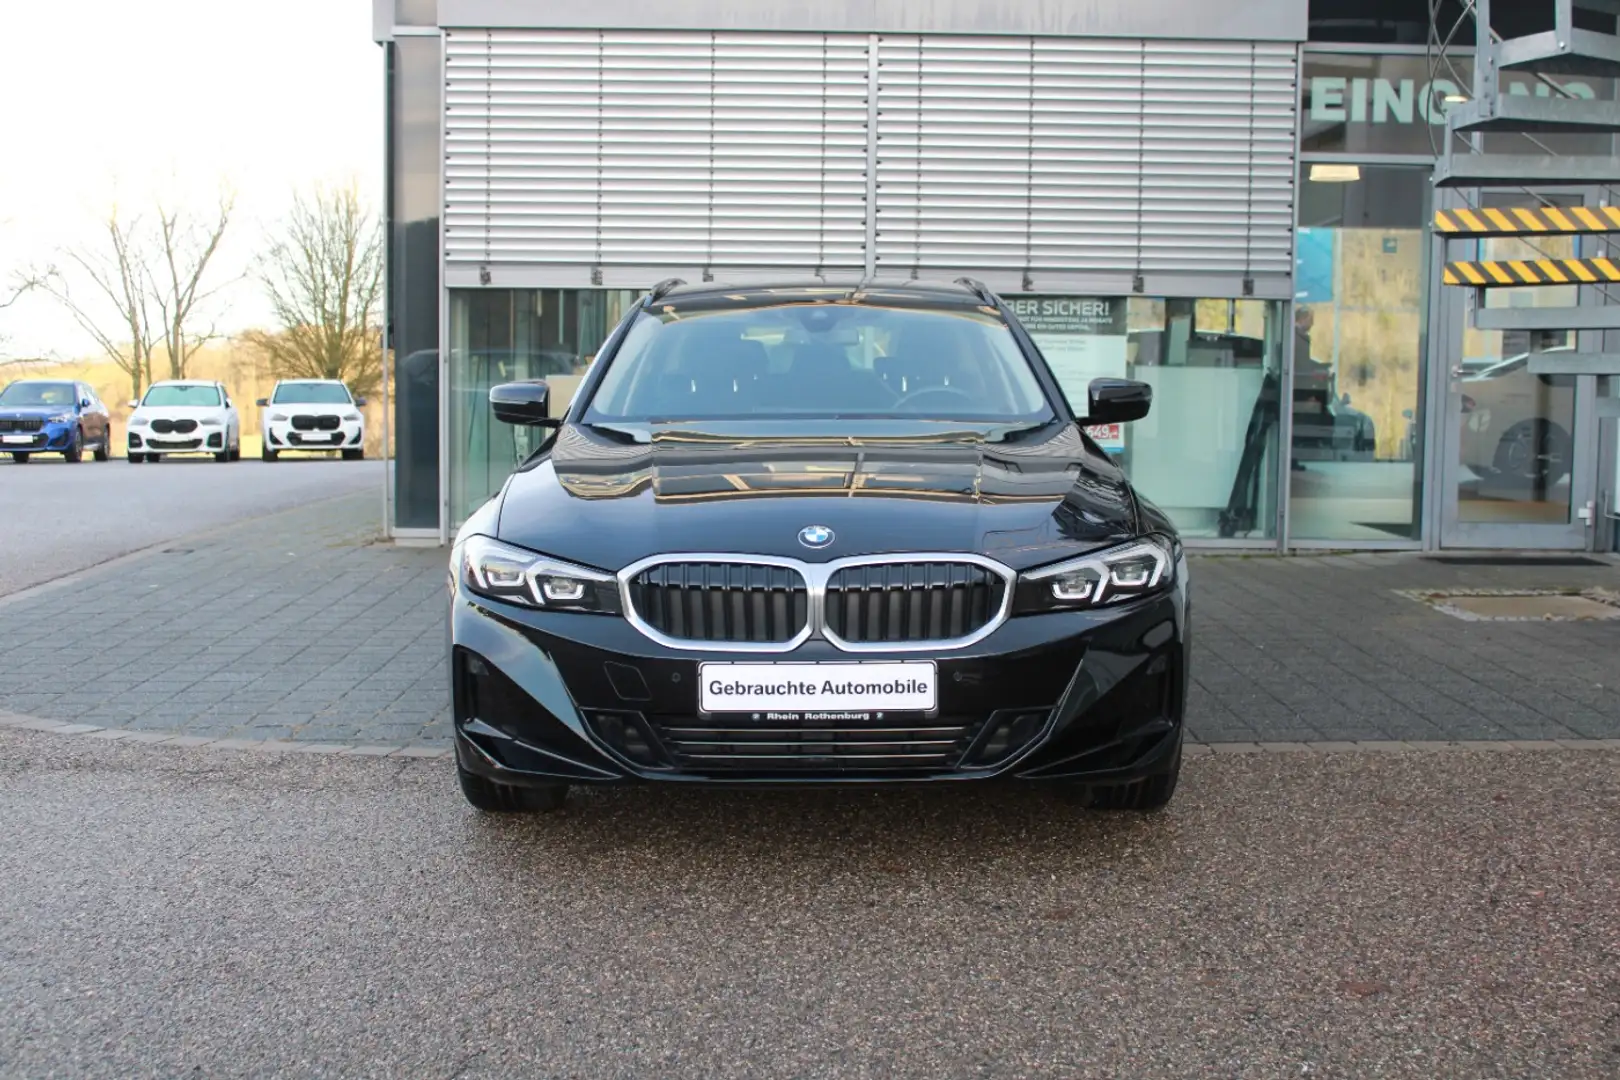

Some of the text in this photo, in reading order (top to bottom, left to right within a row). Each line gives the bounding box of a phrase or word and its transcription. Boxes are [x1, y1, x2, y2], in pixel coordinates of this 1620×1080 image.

[1042, 301, 1109, 316] SICHER!
[709, 679, 928, 695] Gebrauchte Automobile
[767, 712, 869, 721] Rhein Rothenburg
